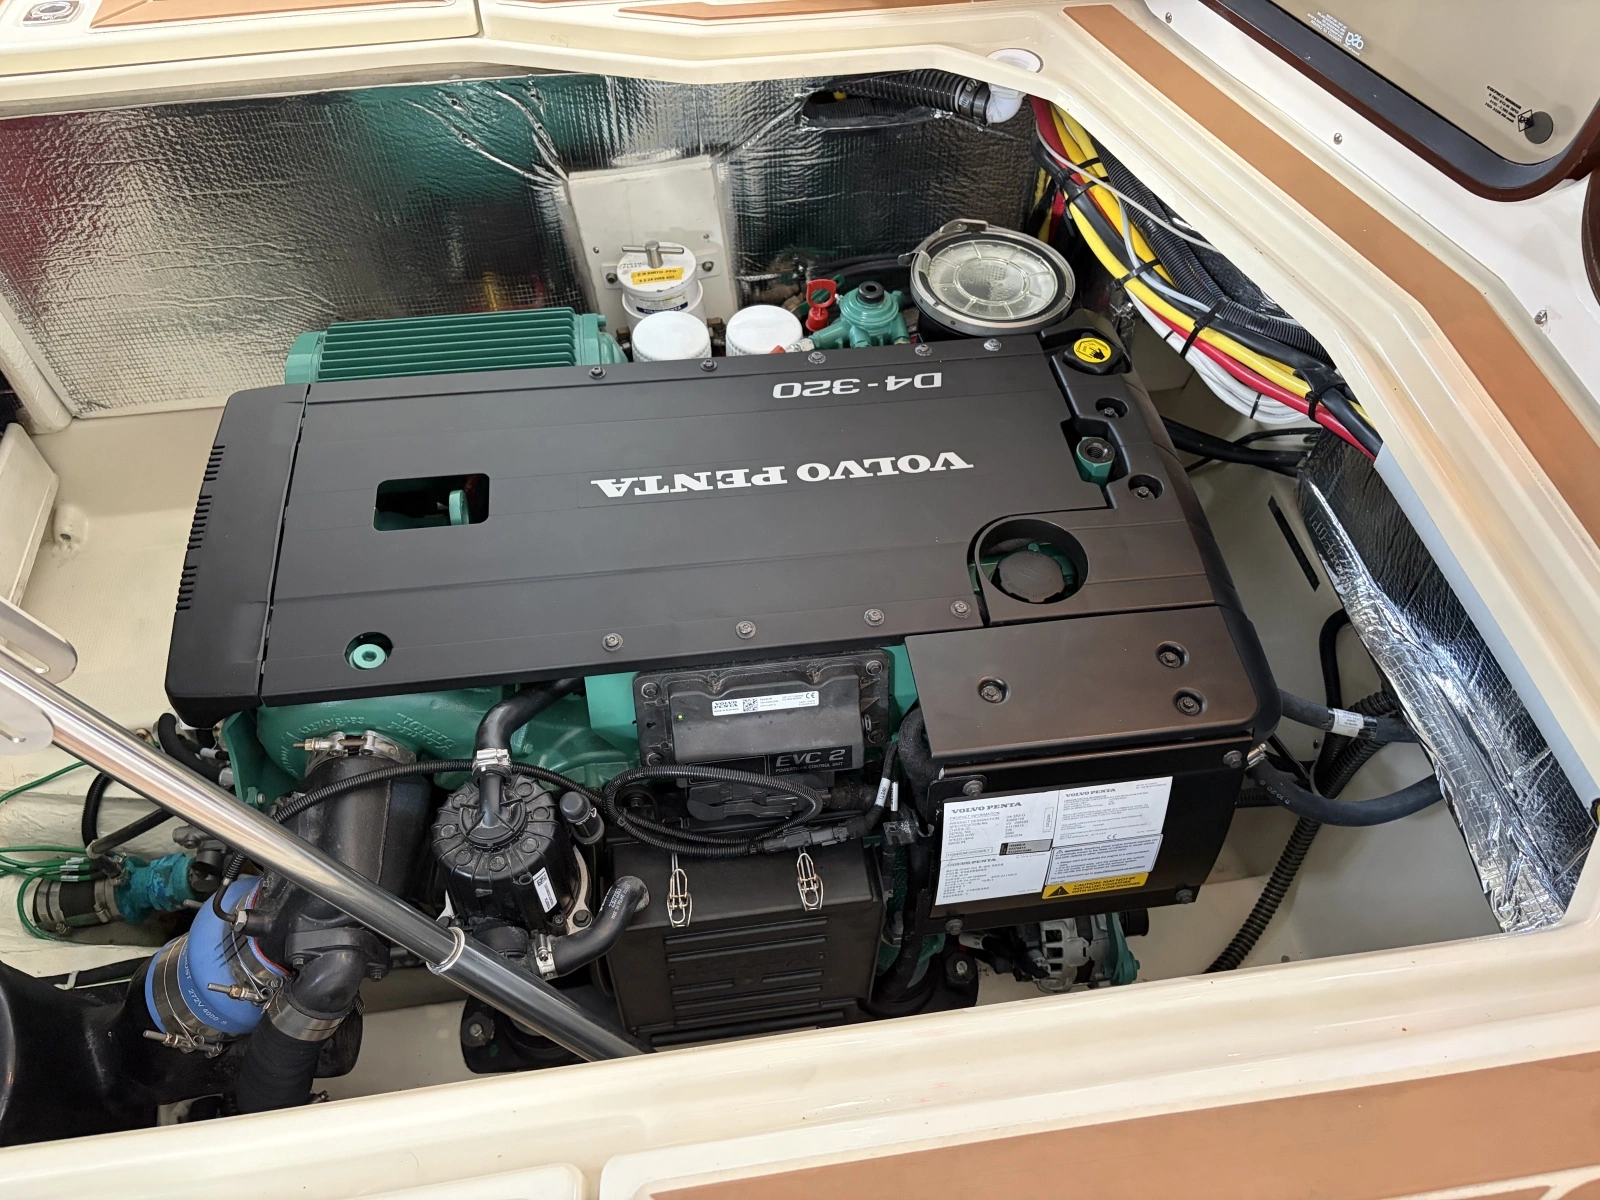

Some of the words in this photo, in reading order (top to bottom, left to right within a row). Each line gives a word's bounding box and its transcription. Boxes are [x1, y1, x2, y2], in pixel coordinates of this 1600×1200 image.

[772, 372, 943, 399] D4-320
[796, 451, 975, 482] VOLVO
[590, 465, 788, 498] PENTA
[776, 751, 822, 767] EVC
[828, 749, 846, 761] 2
[950, 806, 986, 814] VOLVO
[986, 801, 1022, 810] PENTA
[187, 988, 205, 1007] 272V
